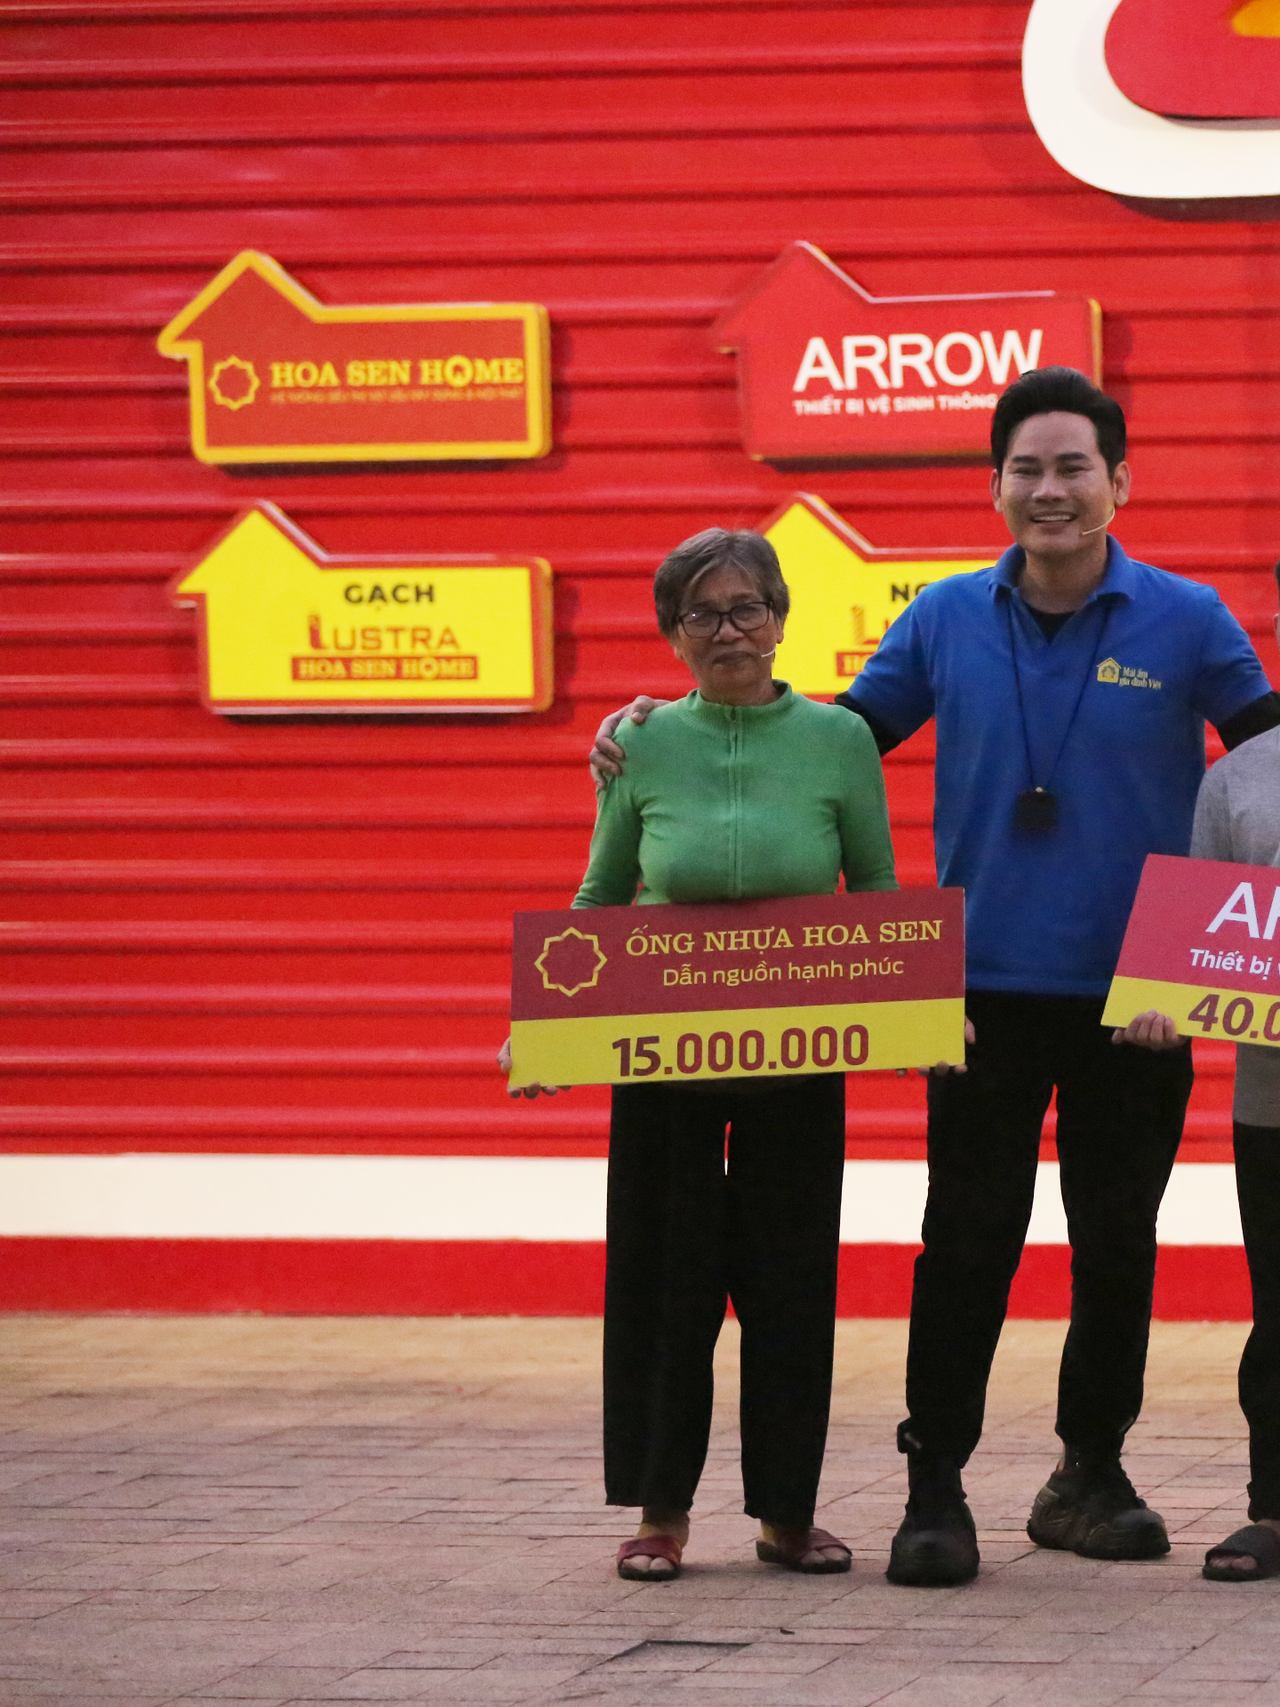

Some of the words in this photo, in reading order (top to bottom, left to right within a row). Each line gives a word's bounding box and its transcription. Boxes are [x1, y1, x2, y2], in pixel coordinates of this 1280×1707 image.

[271, 361, 340, 388] HOA
[347, 359, 411, 387] SEN
[420, 355, 524, 388] HOME
[793, 329, 1043, 392] ARROW
[308, 613, 460, 652] LUSTRA
[299, 659, 348, 679] HOA
[626, 924, 695, 956] ỐNG
[703, 926, 794, 955] NHỰA
[803, 924, 871, 947] HOA
[879, 920, 943, 943] SEN
[663, 963, 707, 986] Dẫn
[713, 961, 782, 987] nguồn
[788, 960, 844, 983] hạnh
[850, 957, 904, 980] phúc
[1190, 949, 1245, 972] Thiết
[1249, 956, 1273, 981] bị
[612, 1024, 869, 1077] 15.000.000
